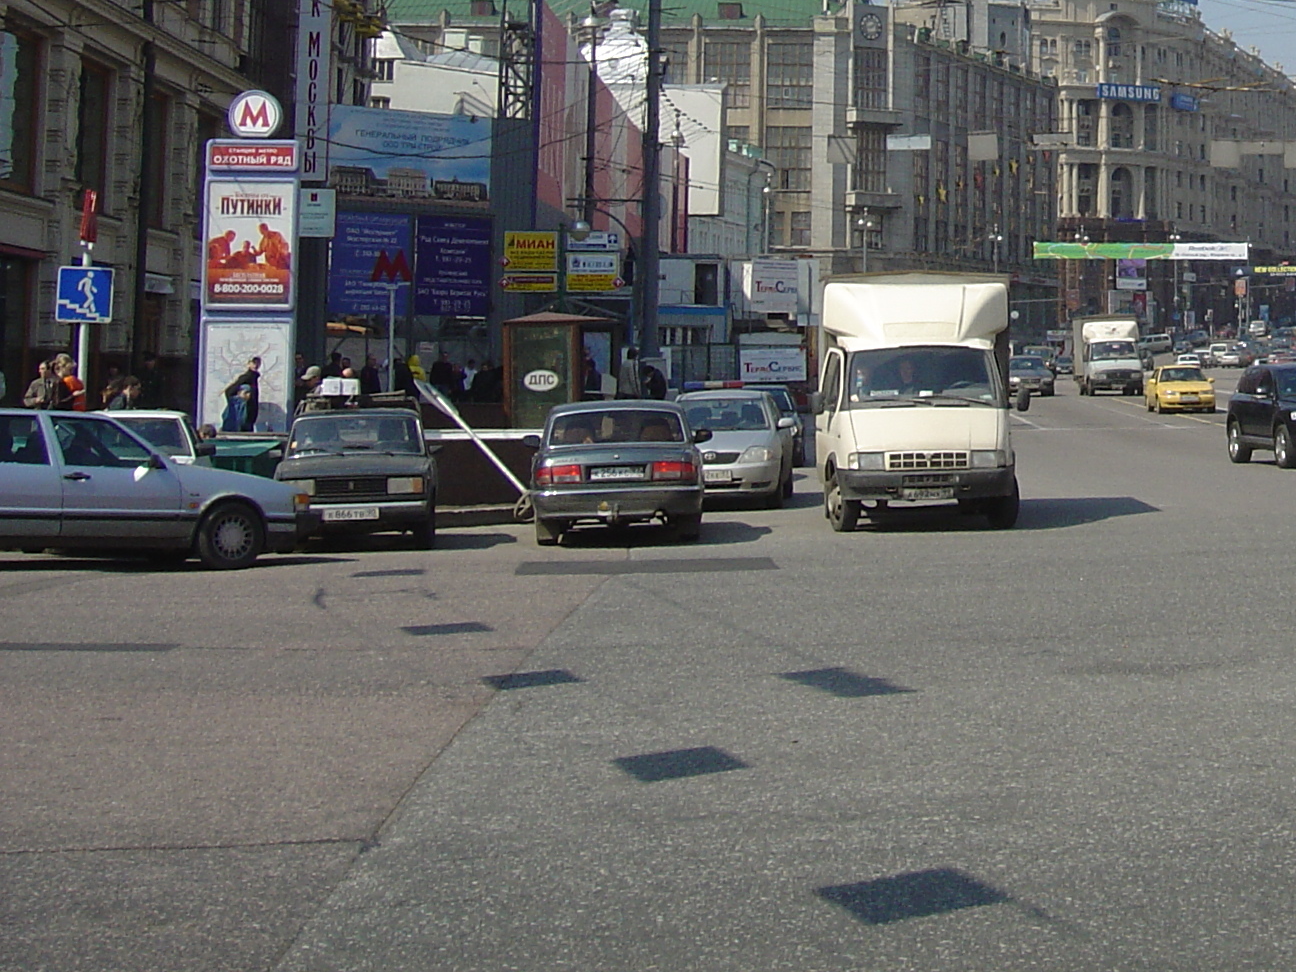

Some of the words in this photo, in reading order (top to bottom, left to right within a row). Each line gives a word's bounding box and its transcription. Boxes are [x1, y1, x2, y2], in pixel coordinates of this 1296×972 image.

[1101, 84, 1160, 101] SAMSUNG
[213, 154, 267, 164] ОХОТНЫЙ
[270, 155, 292, 166] РЯД
[220, 196, 282, 215] ПУТИНКИ
[515, 239, 555, 249] МИАН
[213, 283, 284, 294] 8-800-200-0028
[529, 374, 554, 386] ДПС
